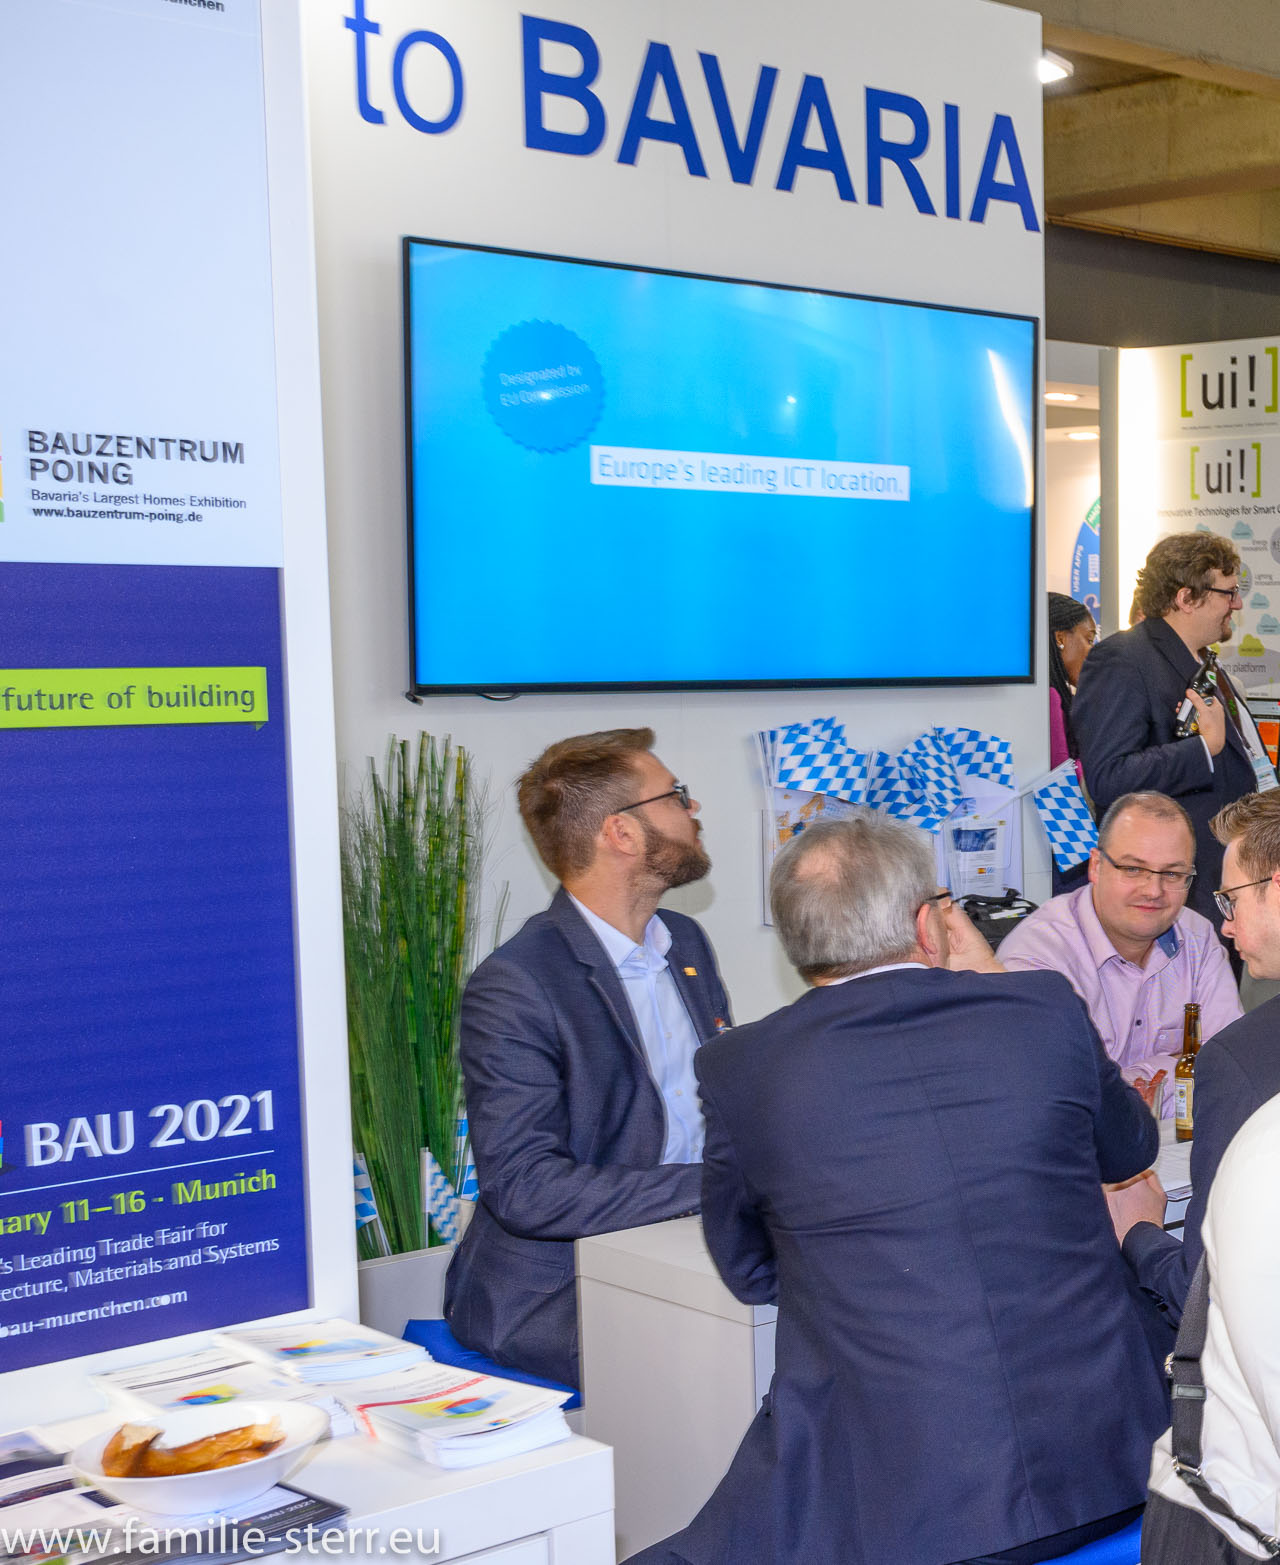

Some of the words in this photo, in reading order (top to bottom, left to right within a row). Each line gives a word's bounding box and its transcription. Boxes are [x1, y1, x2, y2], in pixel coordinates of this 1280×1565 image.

[343, 0, 466, 136] to
[520, 12, 1042, 234] BAVARIA
[27, 430, 245, 465] BAUZENTRUM
[29, 458, 134, 486] POING
[598, 454, 696, 484] Europe's
[700, 460, 778, 493] leading
[784, 467, 816, 490] ICT
[821, 473, 904, 494] location.
[31, 488, 89, 503] Bavaria's
[93, 491, 139, 507] Largest
[143, 493, 186, 507] Homes
[190, 496, 247, 509] Exhibition
[32, 506, 204, 524] www.bauzentrum-poing.de
[1253, 503, 1276, 515] Smart
[2, 687, 95, 712] future
[107, 685, 137, 709] of
[147, 684, 256, 713] building
[24, 1110, 136, 1167] BAU
[147, 1089, 275, 1149] 2021
[171, 1168, 277, 1205] Munich
[13, 1243, 97, 1272] Leading
[96, 1233, 155, 1258] Trade
[155, 1228, 195, 1247] Fair
[196, 1220, 229, 1240] for
[68, 1257, 164, 1289] Materials
[165, 1249, 202, 1272] and
[202, 1237, 281, 1264] Systems
